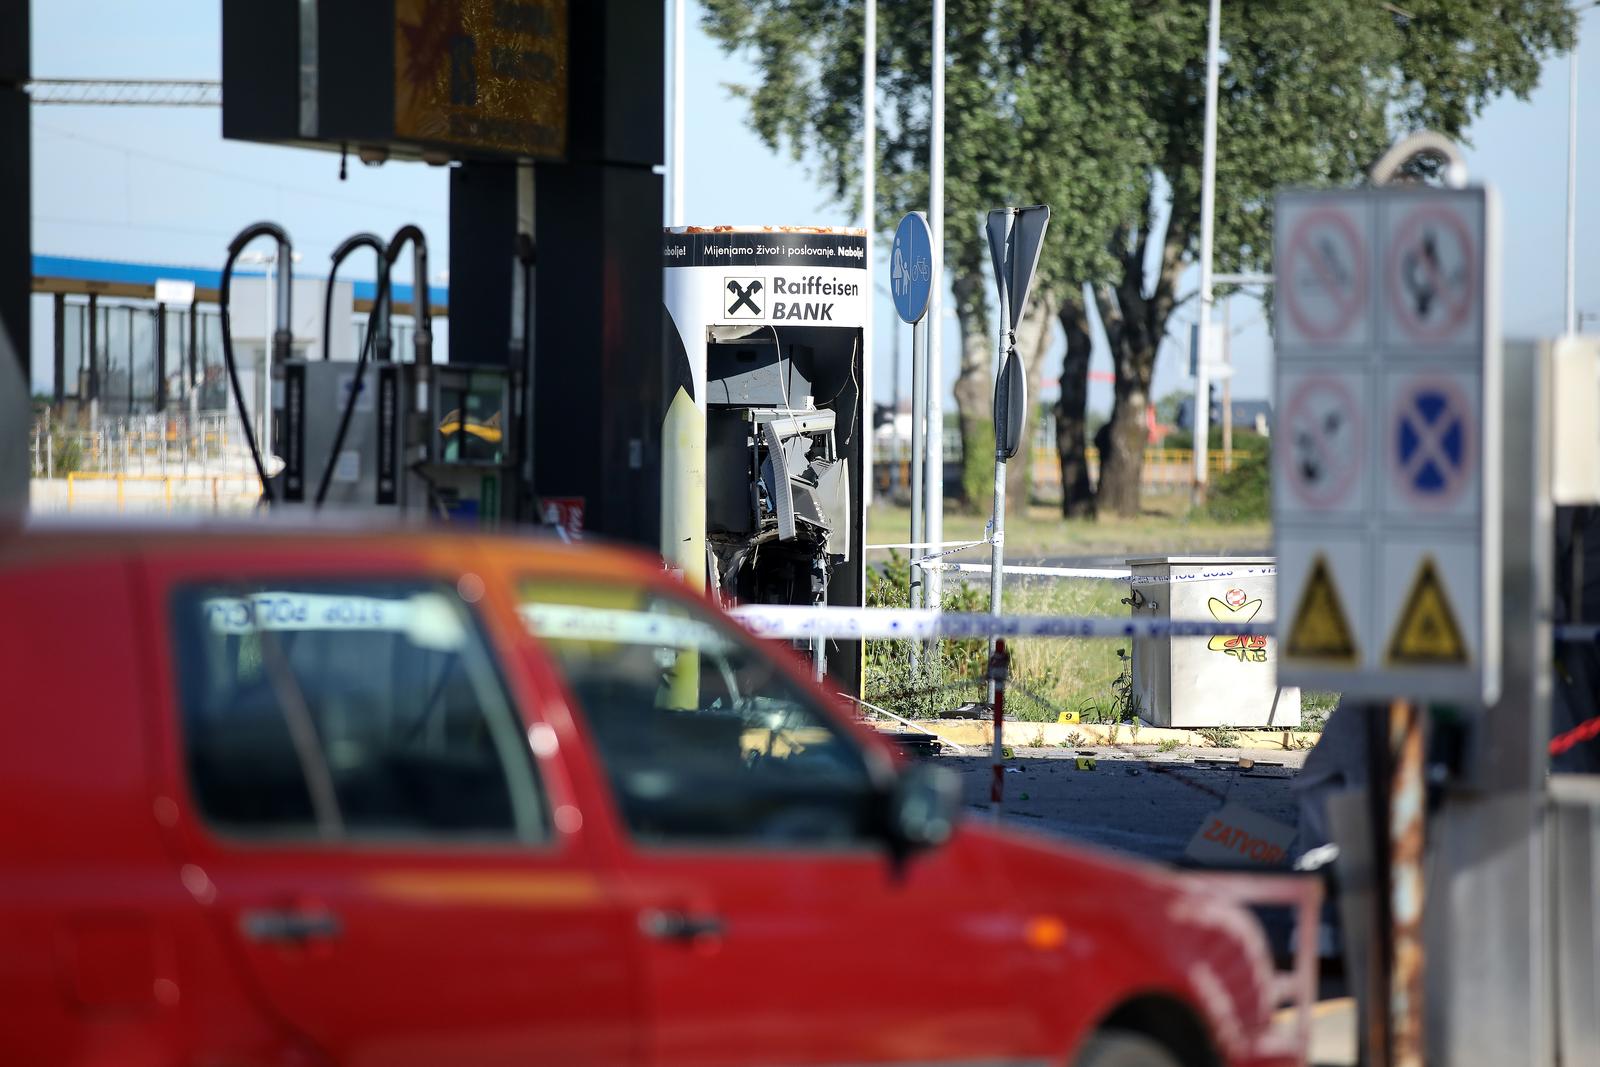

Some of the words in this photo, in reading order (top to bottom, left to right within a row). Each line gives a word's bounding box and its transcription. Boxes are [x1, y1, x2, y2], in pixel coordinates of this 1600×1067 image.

[663, 245, 686, 258] abolje!
[704, 245, 753, 258] Mijenjamo
[755, 244, 780, 255] život
[787, 244, 836, 258] poslovanje.
[837, 245, 864, 260] Nabolje!
[773, 276, 858, 296] Raiffeisen
[772, 302, 834, 321] BANK
[1065, 712, 1073, 721] 9
[1083, 759, 1090, 767] 4
